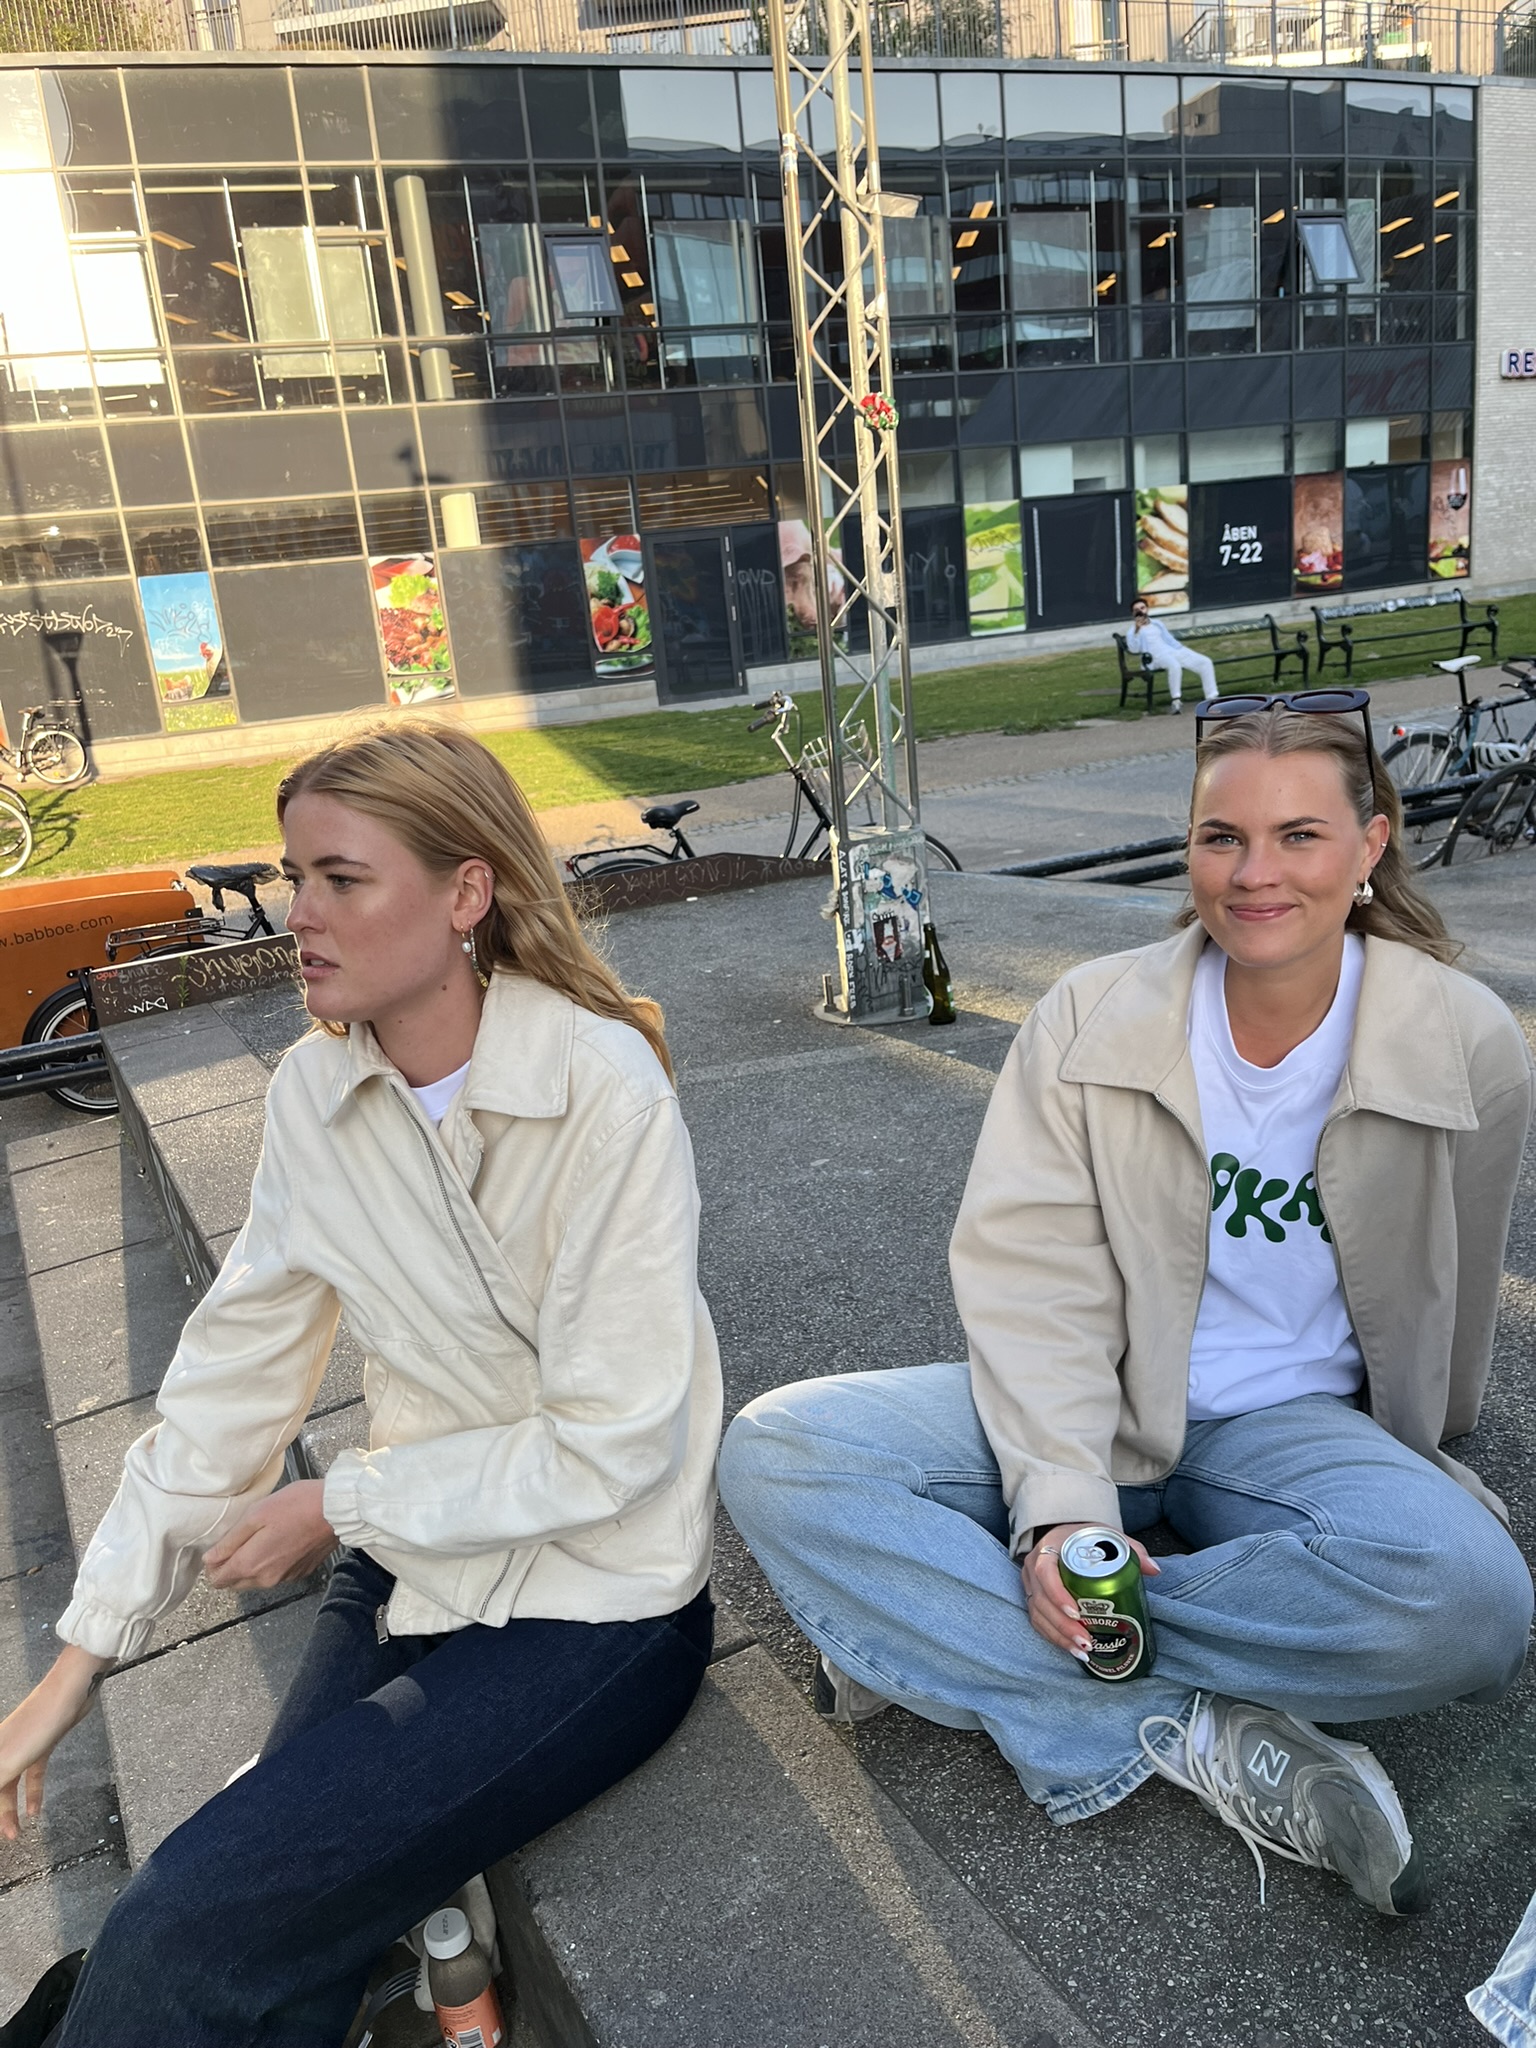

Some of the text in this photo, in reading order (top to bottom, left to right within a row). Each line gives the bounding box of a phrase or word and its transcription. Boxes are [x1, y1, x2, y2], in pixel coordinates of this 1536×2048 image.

[1222, 523, 1257, 542] ÅBEN
[1219, 541, 1263, 567] 7-22
[1089, 1634, 1127, 1650] lassic
[1247, 1739, 1291, 1788] N
